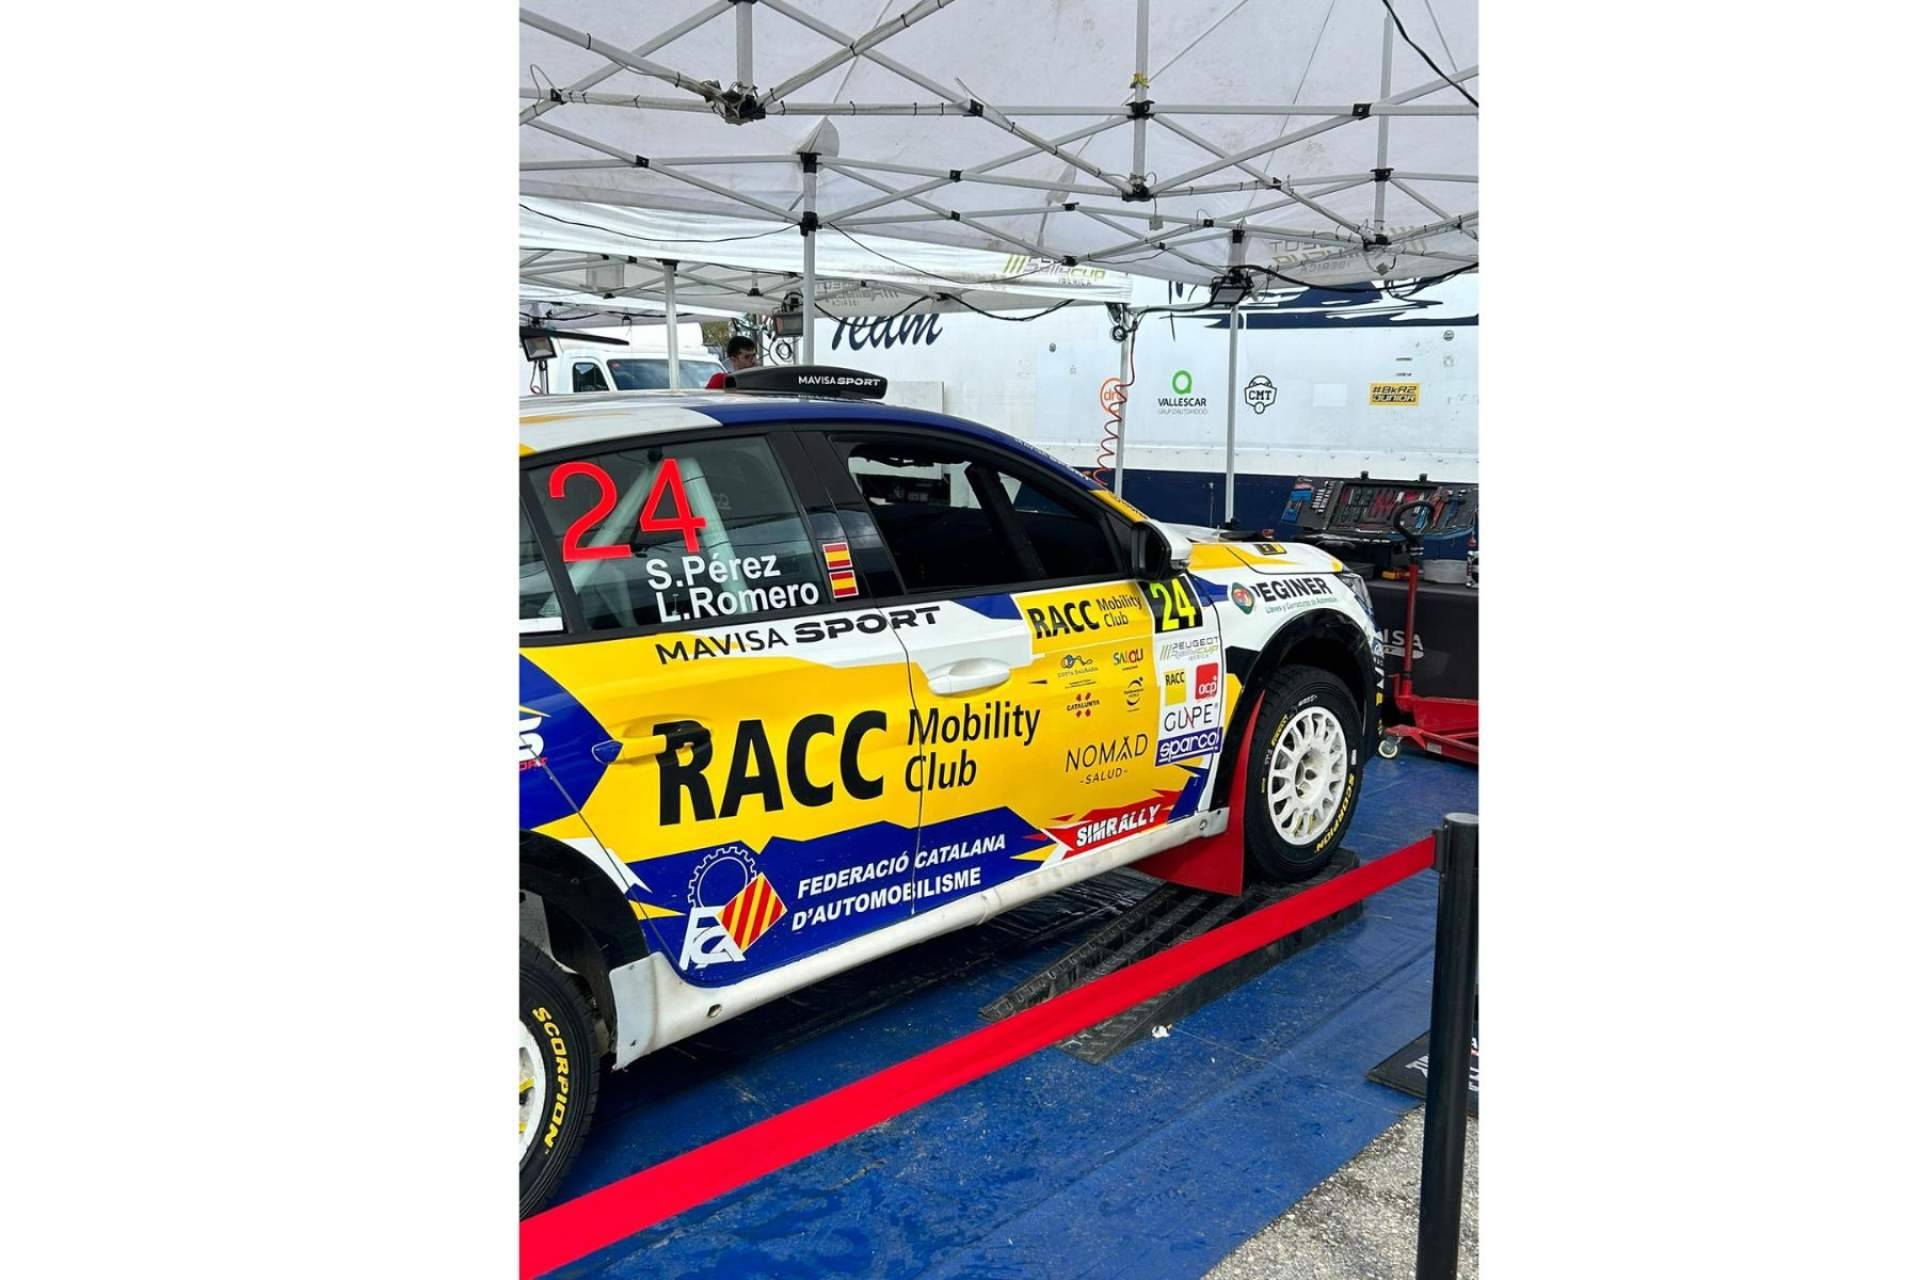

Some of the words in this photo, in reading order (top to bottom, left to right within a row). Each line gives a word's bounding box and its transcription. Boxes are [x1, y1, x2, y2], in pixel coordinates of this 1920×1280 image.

[798, 375, 836, 385] MAVISA
[837, 377, 881, 386] SPORT
[1157, 397, 1207, 407] VALLESCAR
[1249, 389, 1272, 401] CMT
[548, 458, 707, 563] 24
[646, 553, 782, 591] S.Pérez
[655, 582, 819, 624] L.Romero
[1026, 599, 1101, 640] RACC
[1095, 593, 1143, 612] Mobility
[1103, 611, 1129, 628] Club
[1149, 578, 1197, 632] 24
[654, 629, 789, 665] MAVISA
[794, 606, 941, 643] SPORT
[1165, 671, 1185, 686] RACC
[651, 709, 888, 827] RACC
[907, 700, 1041, 750] Mobility
[1065, 734, 1149, 773] NOMAD
[1159, 731, 1219, 763] sparco
[904, 749, 978, 794] Club
[1076, 804, 1162, 847] SIMRALLY
[1314, 773, 1355, 853] SCORPION
[797, 850, 909, 899] FEDERACIÓ
[913, 833, 1006, 869] CATALANA
[791, 867, 982, 932] D'AUTOMOBILISME
[532, 1006, 570, 1148] SCORPION
